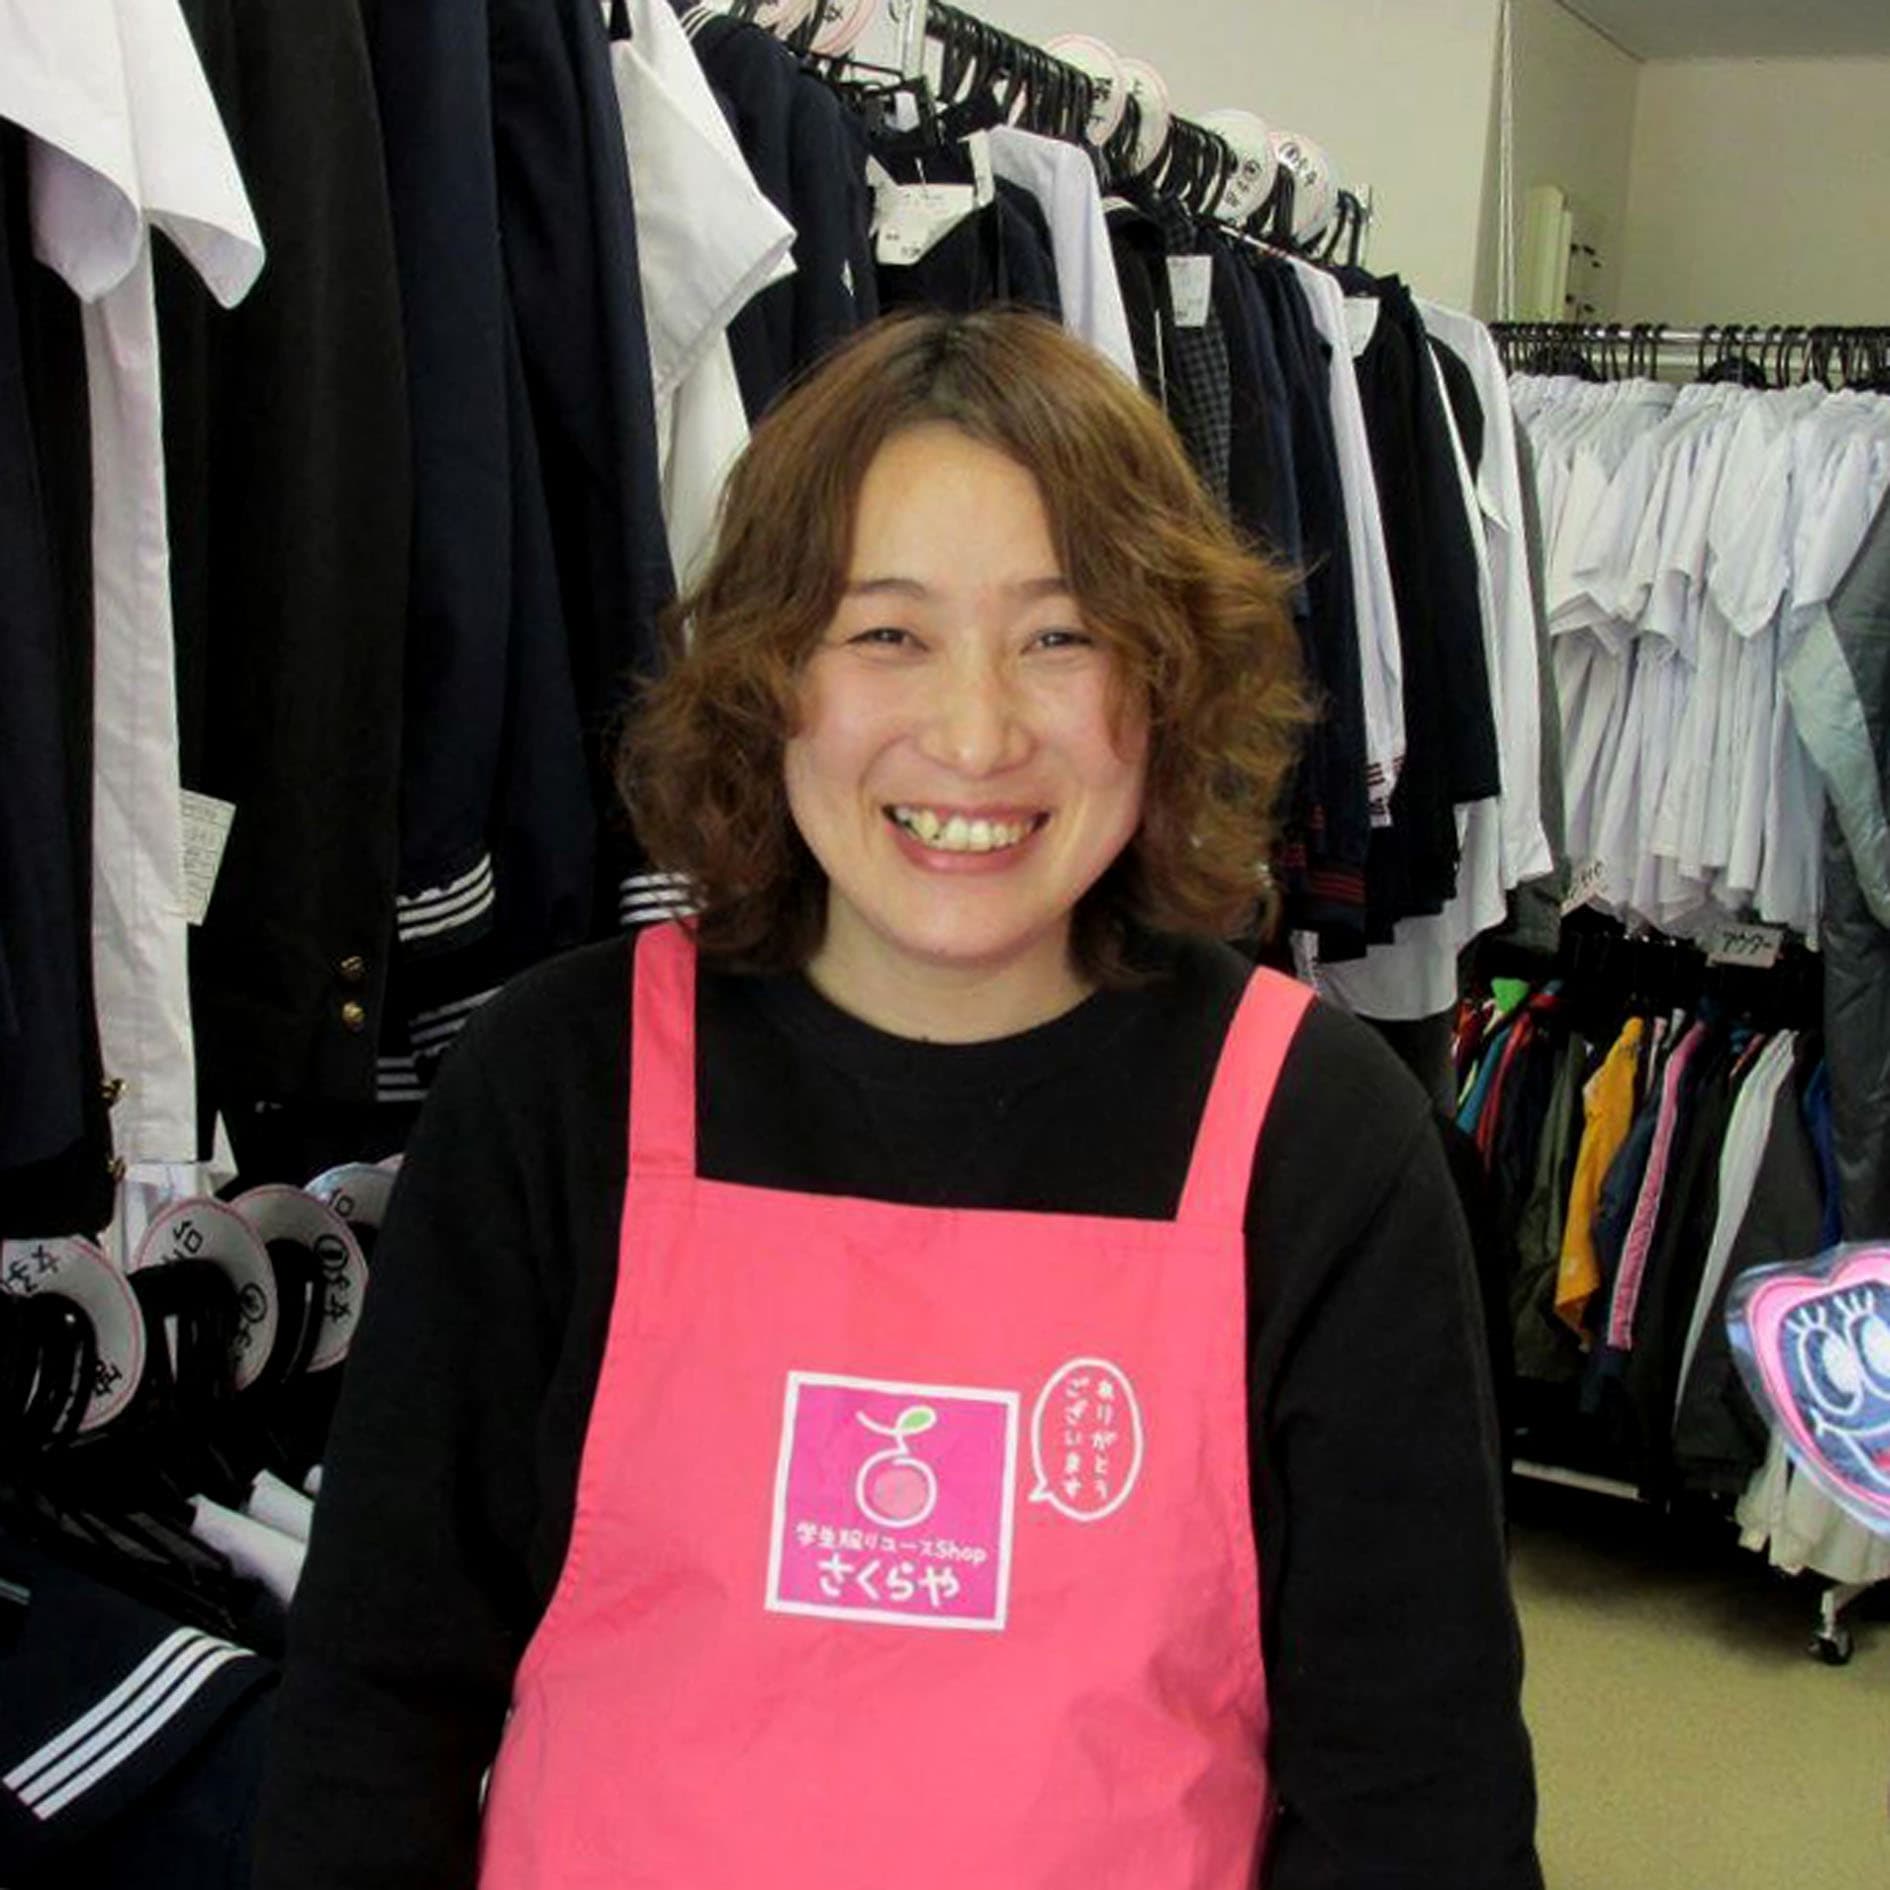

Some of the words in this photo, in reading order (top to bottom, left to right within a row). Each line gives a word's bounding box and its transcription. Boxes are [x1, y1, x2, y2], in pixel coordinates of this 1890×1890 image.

[1062, 1376, 1090, 1499] ございます
[1092, 1380, 1117, 1500] ありがとう
[816, 1551, 960, 1607] さくらや
